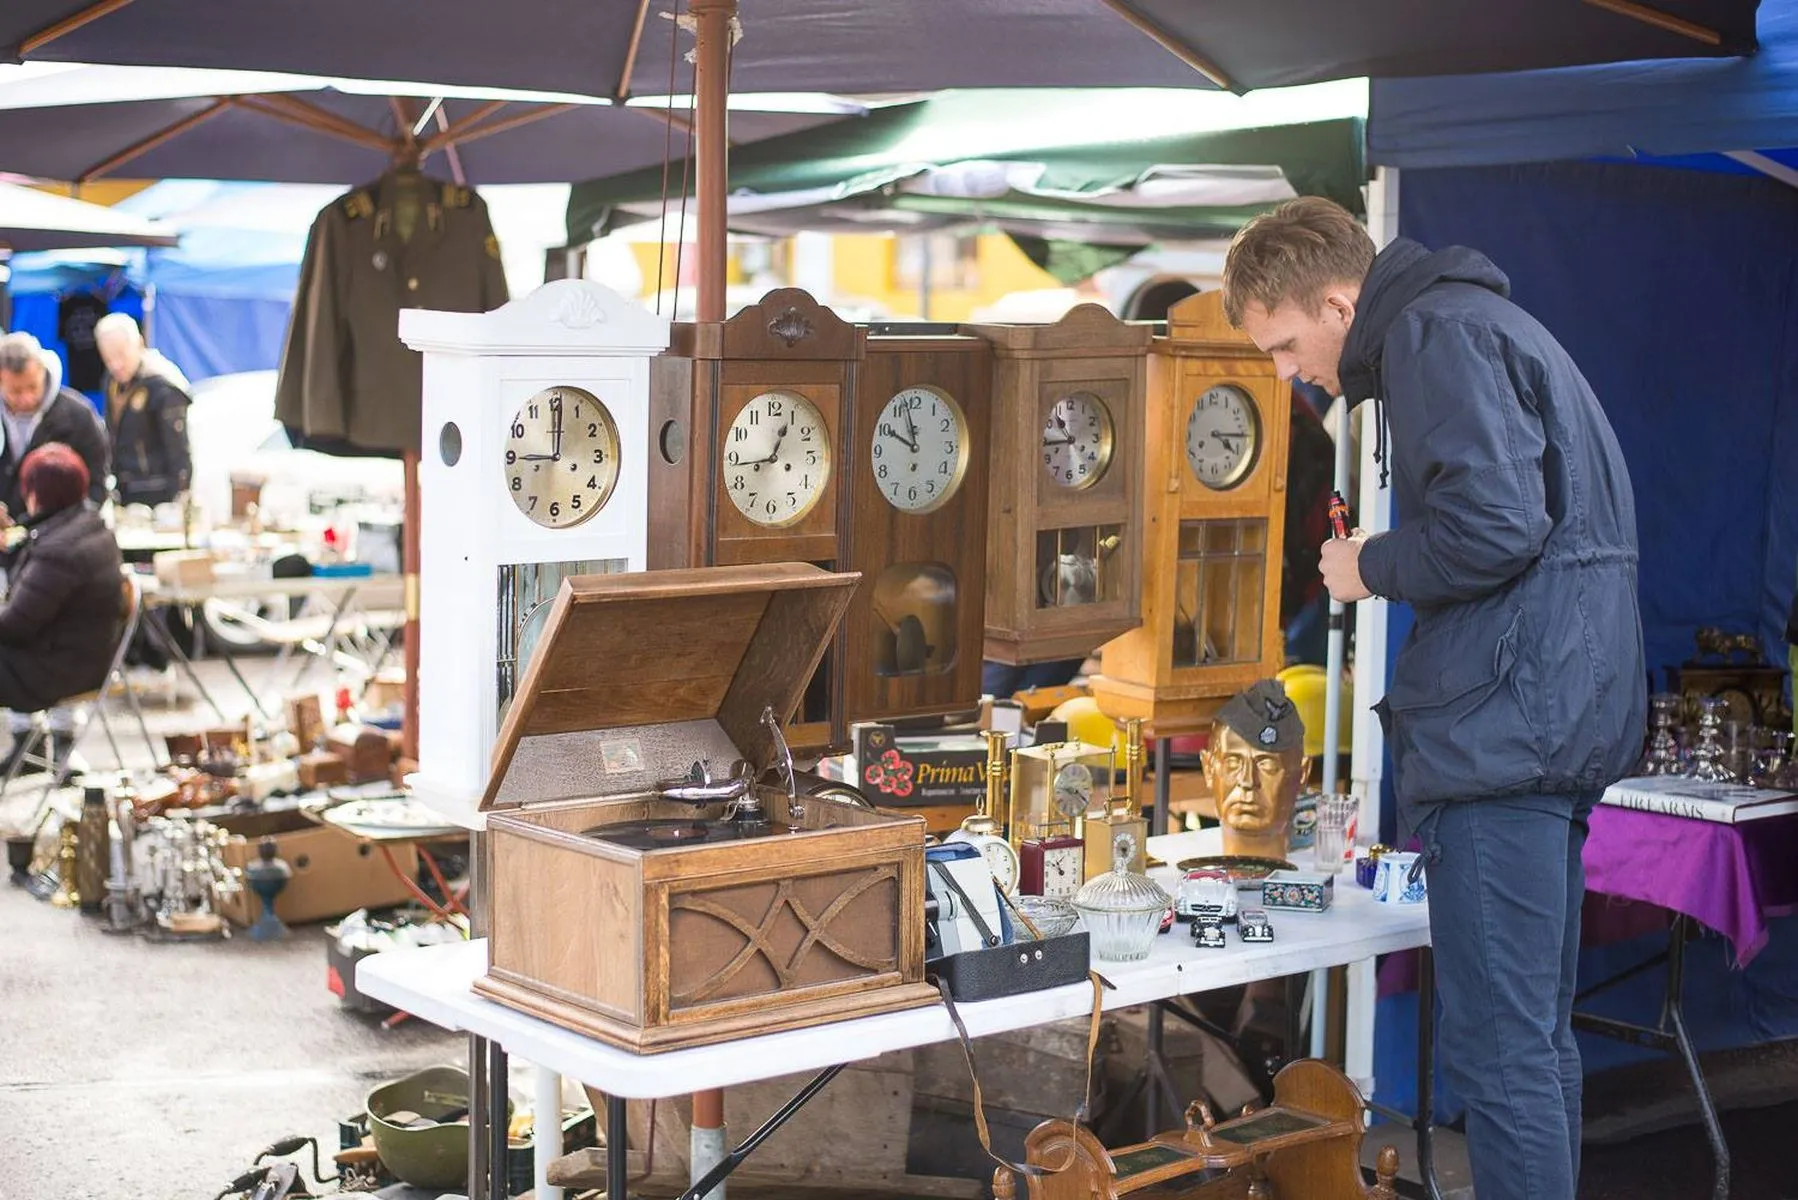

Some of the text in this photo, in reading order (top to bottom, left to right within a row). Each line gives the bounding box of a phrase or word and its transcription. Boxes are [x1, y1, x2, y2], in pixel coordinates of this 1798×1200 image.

[768, 401, 782, 417] 12
[909, 396, 922, 410] 12
[931, 402, 936, 417] 1
[1066, 400, 1075, 411] 12
[528, 404, 538, 419] 11
[574, 404, 580, 418] 1
[750, 410, 759, 425] 11
[791, 410, 795, 426] 1
[941, 418, 950, 433] 2
[1089, 416, 1096, 427] 2
[511, 423, 525, 438] 10
[588, 423, 597, 438] 2
[735, 427, 748, 442] 10
[801, 426, 811, 442] 2
[879, 423, 891, 437] 10
[1092, 433, 1099, 444] 3
[874, 444, 882, 459] 9
[944, 440, 954, 455] 3
[506, 450, 516, 465] 9
[593, 449, 603, 464] 3
[728, 451, 739, 467] 9
[1088, 451, 1096, 461] 4
[878, 464, 887, 479] 8
[938, 460, 948, 475] 4
[1052, 465, 1060, 476] 7
[1065, 469, 1073, 480] 6
[1078, 463, 1086, 474] 5
[511, 477, 522, 491] 8
[587, 475, 597, 490] 4
[734, 475, 745, 490] 8
[891, 481, 900, 496] 7
[926, 480, 935, 494] 5
[748, 492, 757, 508] 7
[787, 492, 796, 507] 5
[908, 486, 917, 501] 6
[528, 496, 538, 511] 7
[549, 502, 559, 517] 6
[571, 495, 581, 509] 5
[766, 500, 776, 515] 6
[916, 758, 974, 785] Prima
